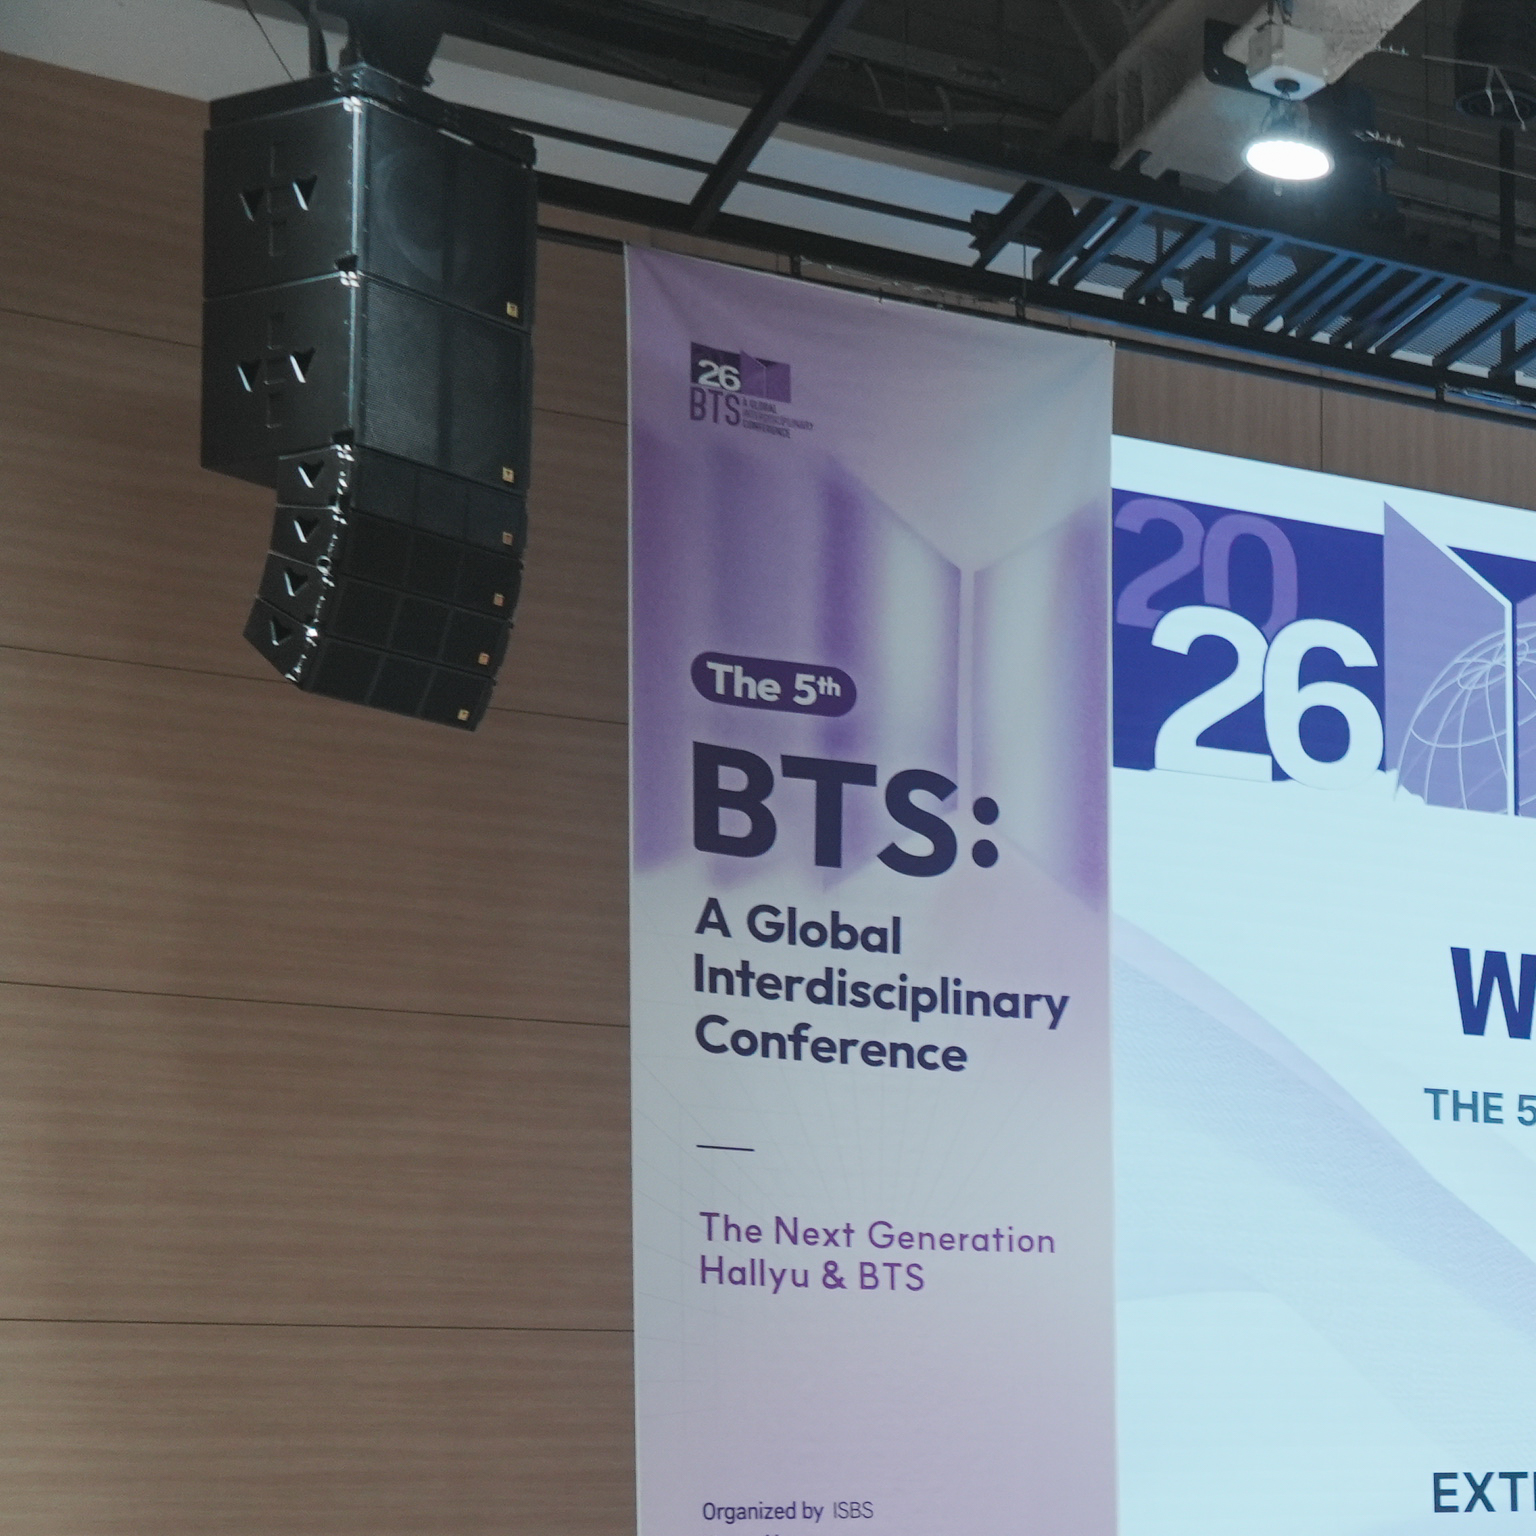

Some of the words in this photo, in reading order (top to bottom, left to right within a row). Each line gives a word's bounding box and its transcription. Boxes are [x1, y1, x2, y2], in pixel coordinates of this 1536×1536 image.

[698, 359, 741, 392] 26
[689, 386, 741, 426] BTS
[1114, 498, 1298, 642] 20
[706, 661, 781, 702] The
[793, 673, 841, 706] 5th
[1151, 605, 1384, 790] 26
[692, 741, 999, 877] BTS:
[694, 897, 732, 938] A
[746, 904, 901, 954] Global
[694, 953, 1070, 1029] Interdisciplinary
[695, 1014, 968, 1071] Conference
[1424, 1088, 1504, 1125] THE
[699, 1212, 763, 1243] The
[774, 1216, 855, 1248] Next
[868, 1221, 1056, 1253] Generation
[700, 1255, 809, 1294] Hallyu
[822, 1261, 848, 1290] &
[859, 1261, 925, 1291] BTS
[703, 1502, 796, 1524] Organized
[802, 1502, 824, 1523] by
[833, 1502, 874, 1519] ISBS
